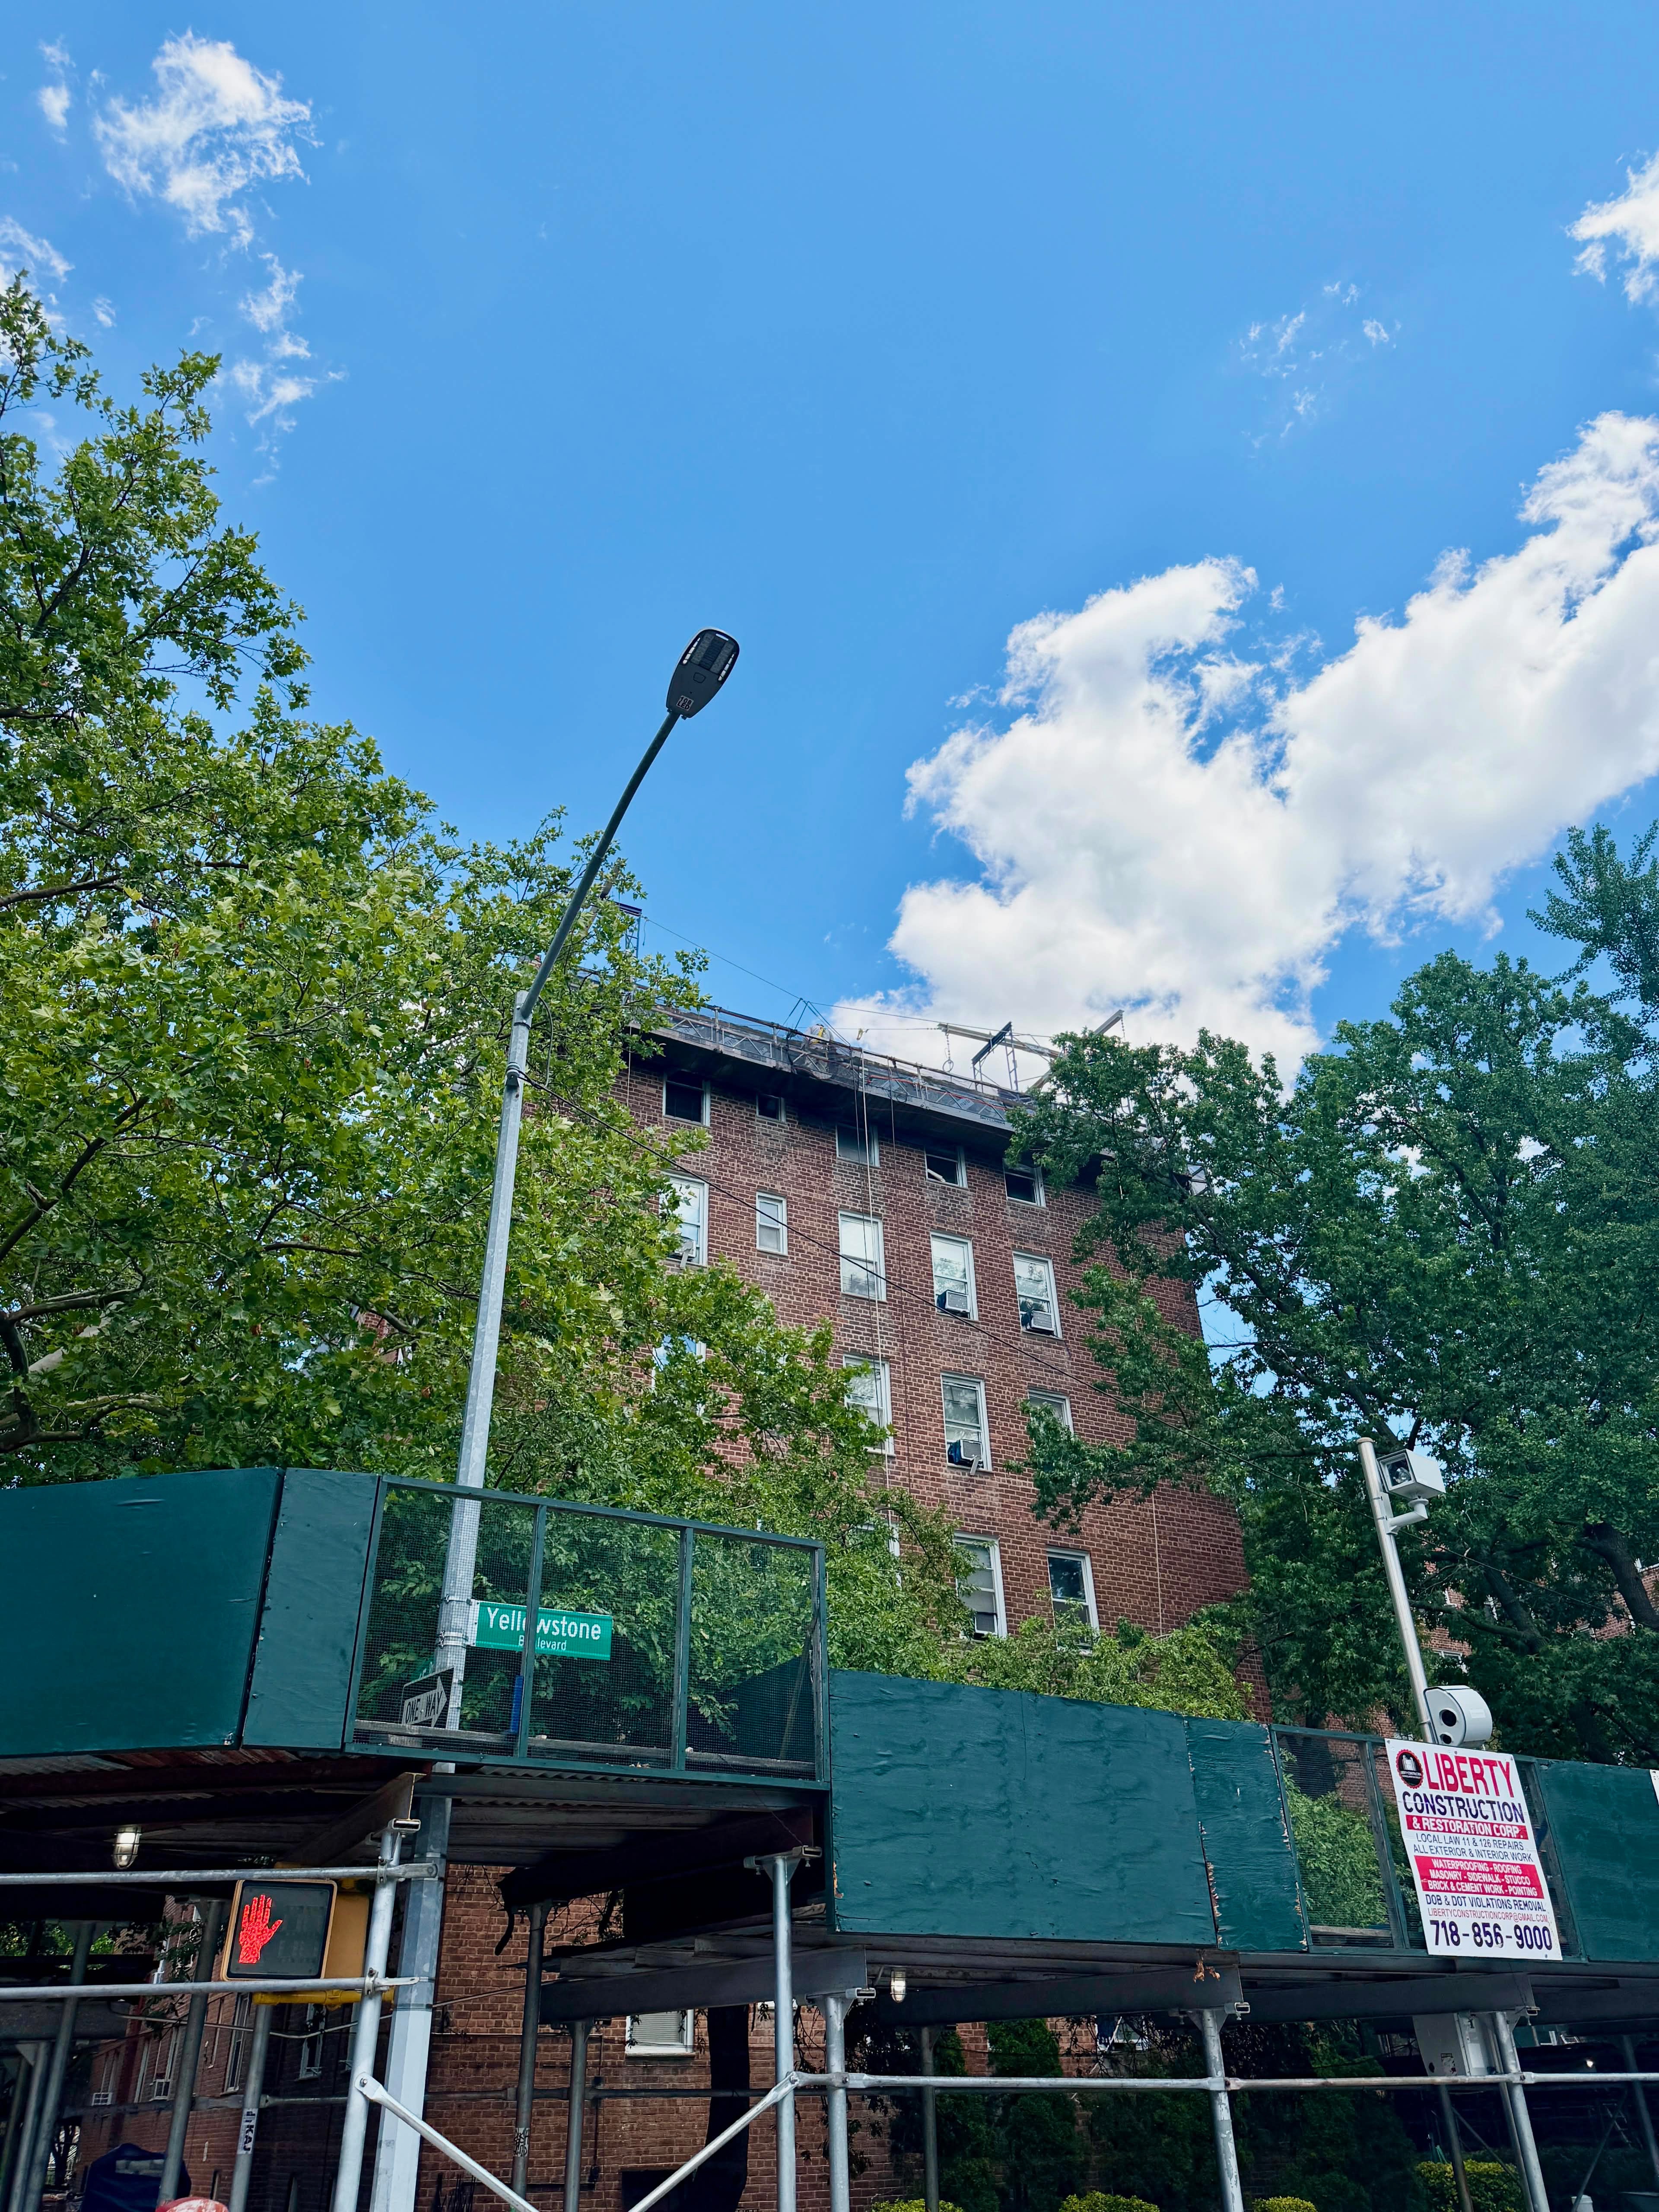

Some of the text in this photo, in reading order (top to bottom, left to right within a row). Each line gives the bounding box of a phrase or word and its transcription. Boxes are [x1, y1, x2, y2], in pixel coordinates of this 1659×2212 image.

[677, 701, 690, 709] LED
[518, 1635, 567, 1651] Blevard
[405, 1690, 443, 1724] ONE WAY
[1422, 1751, 1514, 1798] LIBERTY
[1402, 1791, 1525, 1823] CONSTRUCTION
[1412, 1817, 1523, 1838] & RESTORATION CORP.
[1416, 1833, 1524, 1850] LOCAL LAW 11 & 126 REPAIRS
[1414, 1844, 1534, 1862] ALL EXTERIOR & INTERIOR WORK
[1431, 1858, 1489, 1872] WATERPROOFING
[1493, 1863, 1522, 1875] ROOFING
[1429, 1869, 1462, 1880] MASONRY
[1467, 1872, 1502, 1884] SIDEWALK
[1504, 1875, 1531, 1886] STUCCO
[1427, 1880, 1450, 1891] BRICK
[1450, 1882, 1456, 1891] &
[1456, 1882, 1483, 1893] CEMENT
[1483, 1884, 1504, 1894] WORK
[1507, 1886, 1538, 1897] POINTING
[1425, 1894, 1547, 1912] DOB & DOT VIOLATIONS REMOVAL
[1430, 1920, 1553, 1951] 718-856-9000
